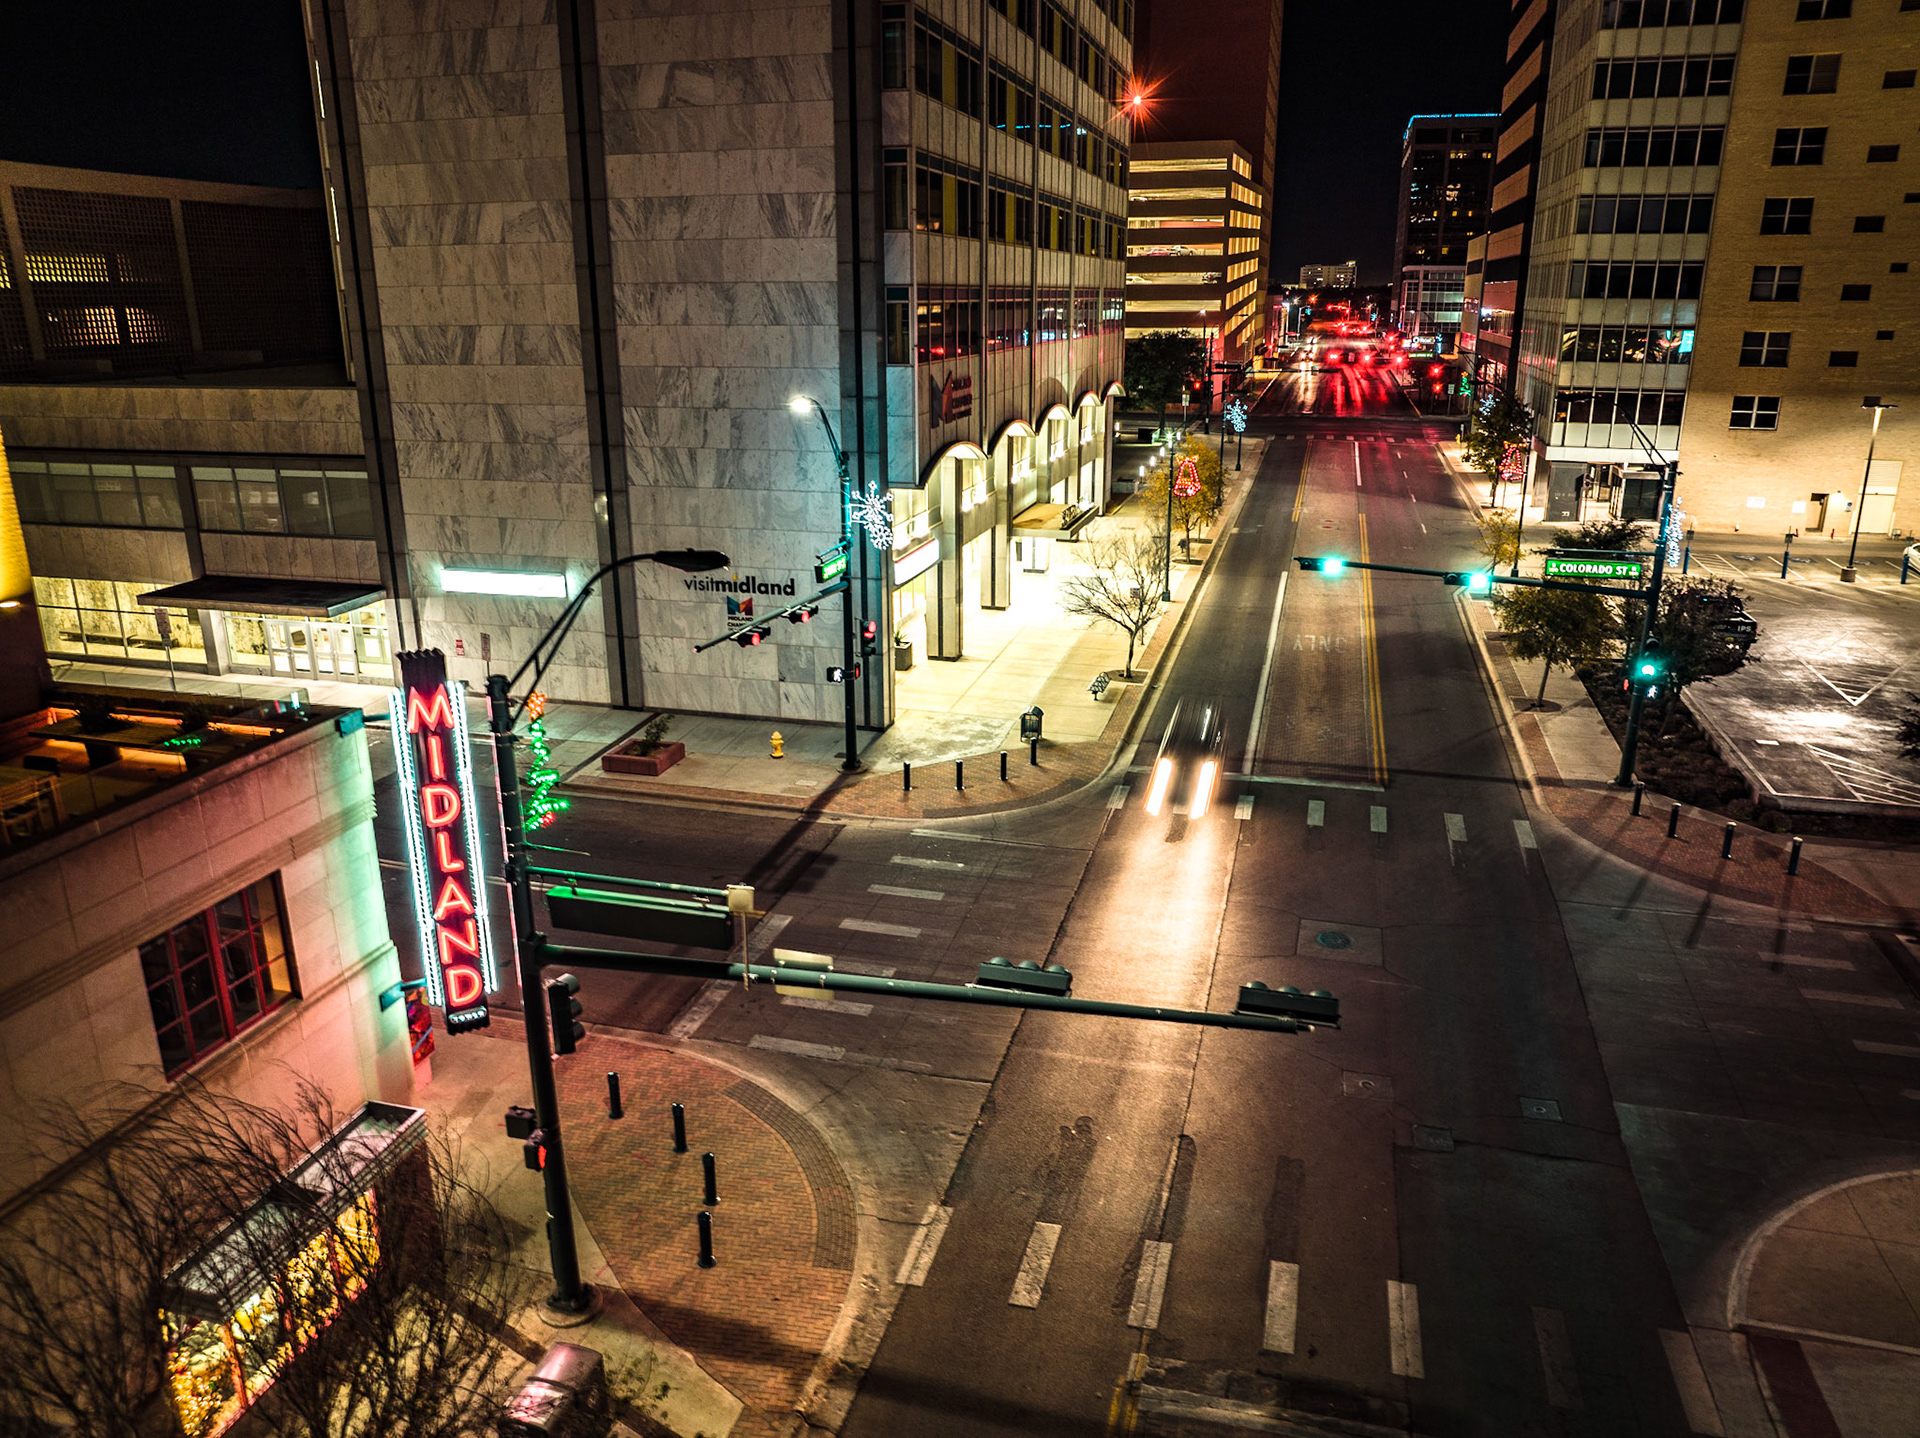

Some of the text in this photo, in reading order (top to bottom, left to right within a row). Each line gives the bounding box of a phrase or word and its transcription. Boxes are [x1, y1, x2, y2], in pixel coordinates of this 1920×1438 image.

[1560, 563, 1613, 575] COLORADO
[1616, 566, 1629, 576] ST
[684, 573, 796, 597] visitmidland
[407, 683, 484, 1007] MIDLAND
